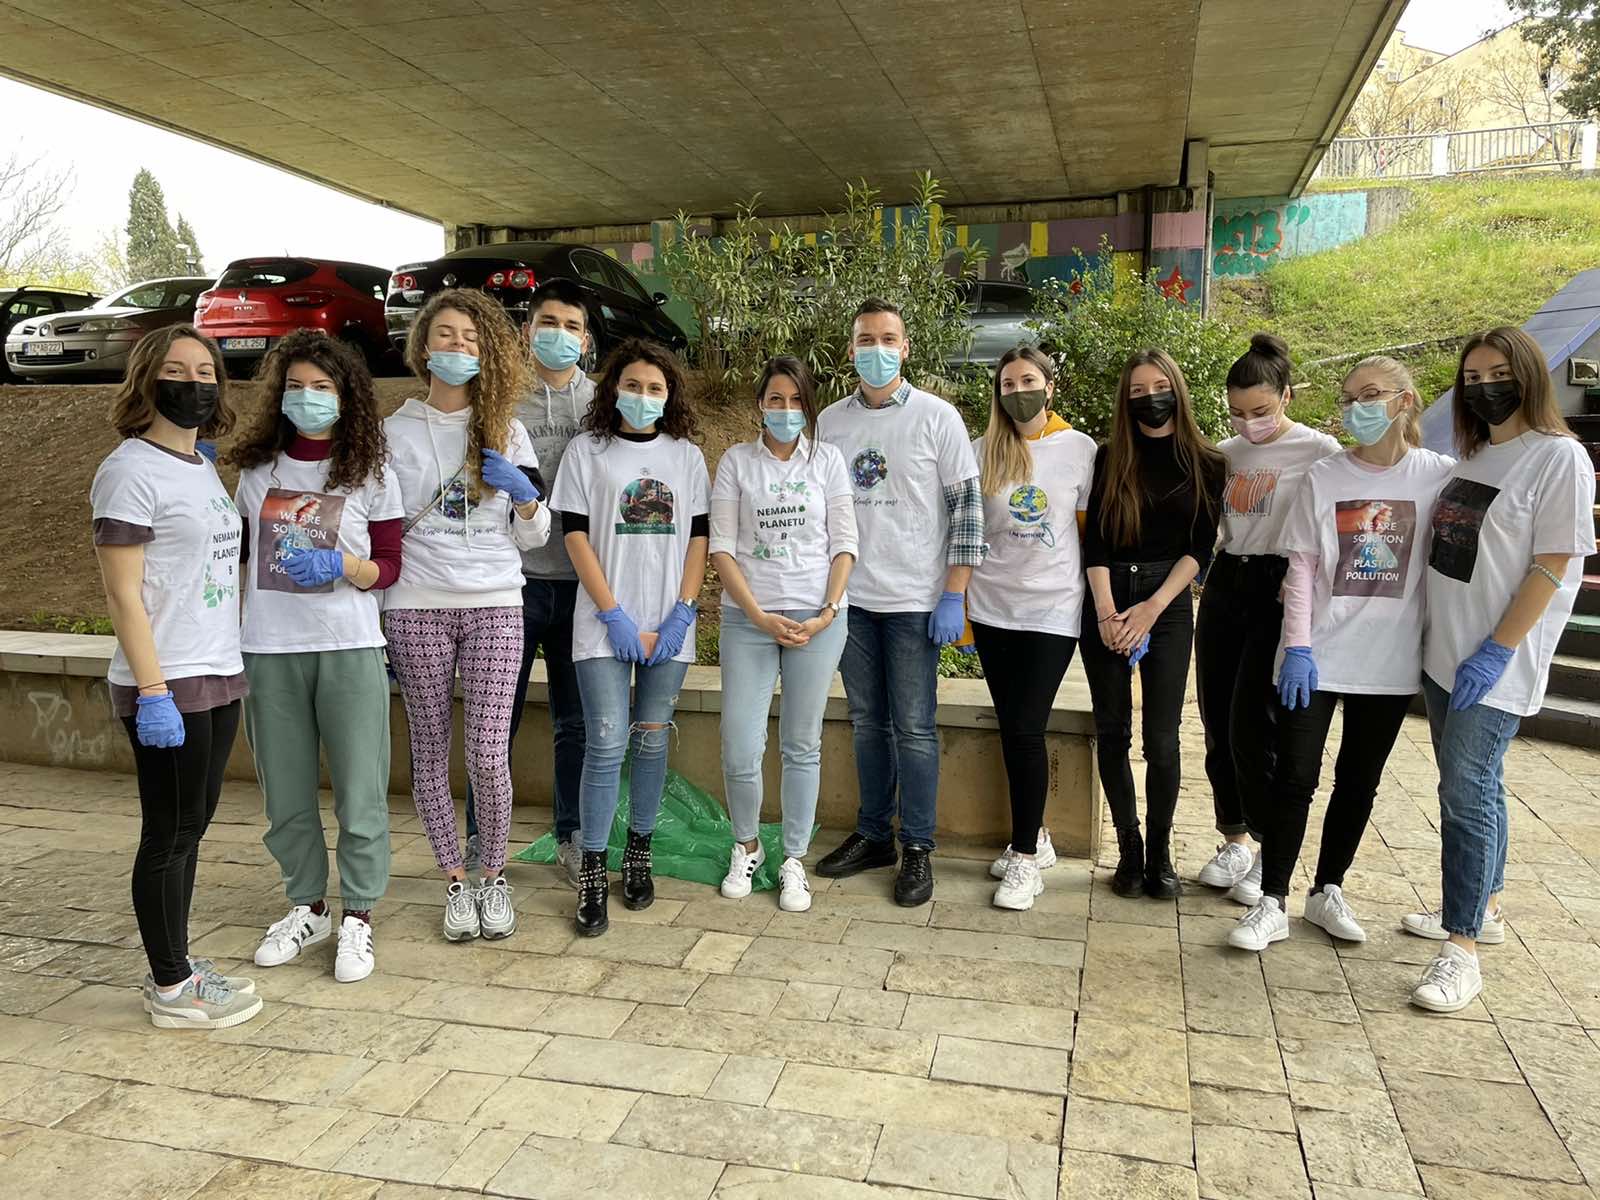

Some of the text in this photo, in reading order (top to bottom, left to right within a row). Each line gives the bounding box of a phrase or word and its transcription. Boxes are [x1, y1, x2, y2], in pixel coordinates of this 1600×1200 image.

[756, 506, 797, 517] NEMAM
[280, 511, 321, 525] WE ARE
[759, 517, 805, 529] PLANETU
[1355, 521, 1398, 531] WE ARE
[212, 531, 236, 544] NEMAM
[1353, 559, 1394, 569] PLASTIC
[1345, 571, 1399, 581] POLLUTION
